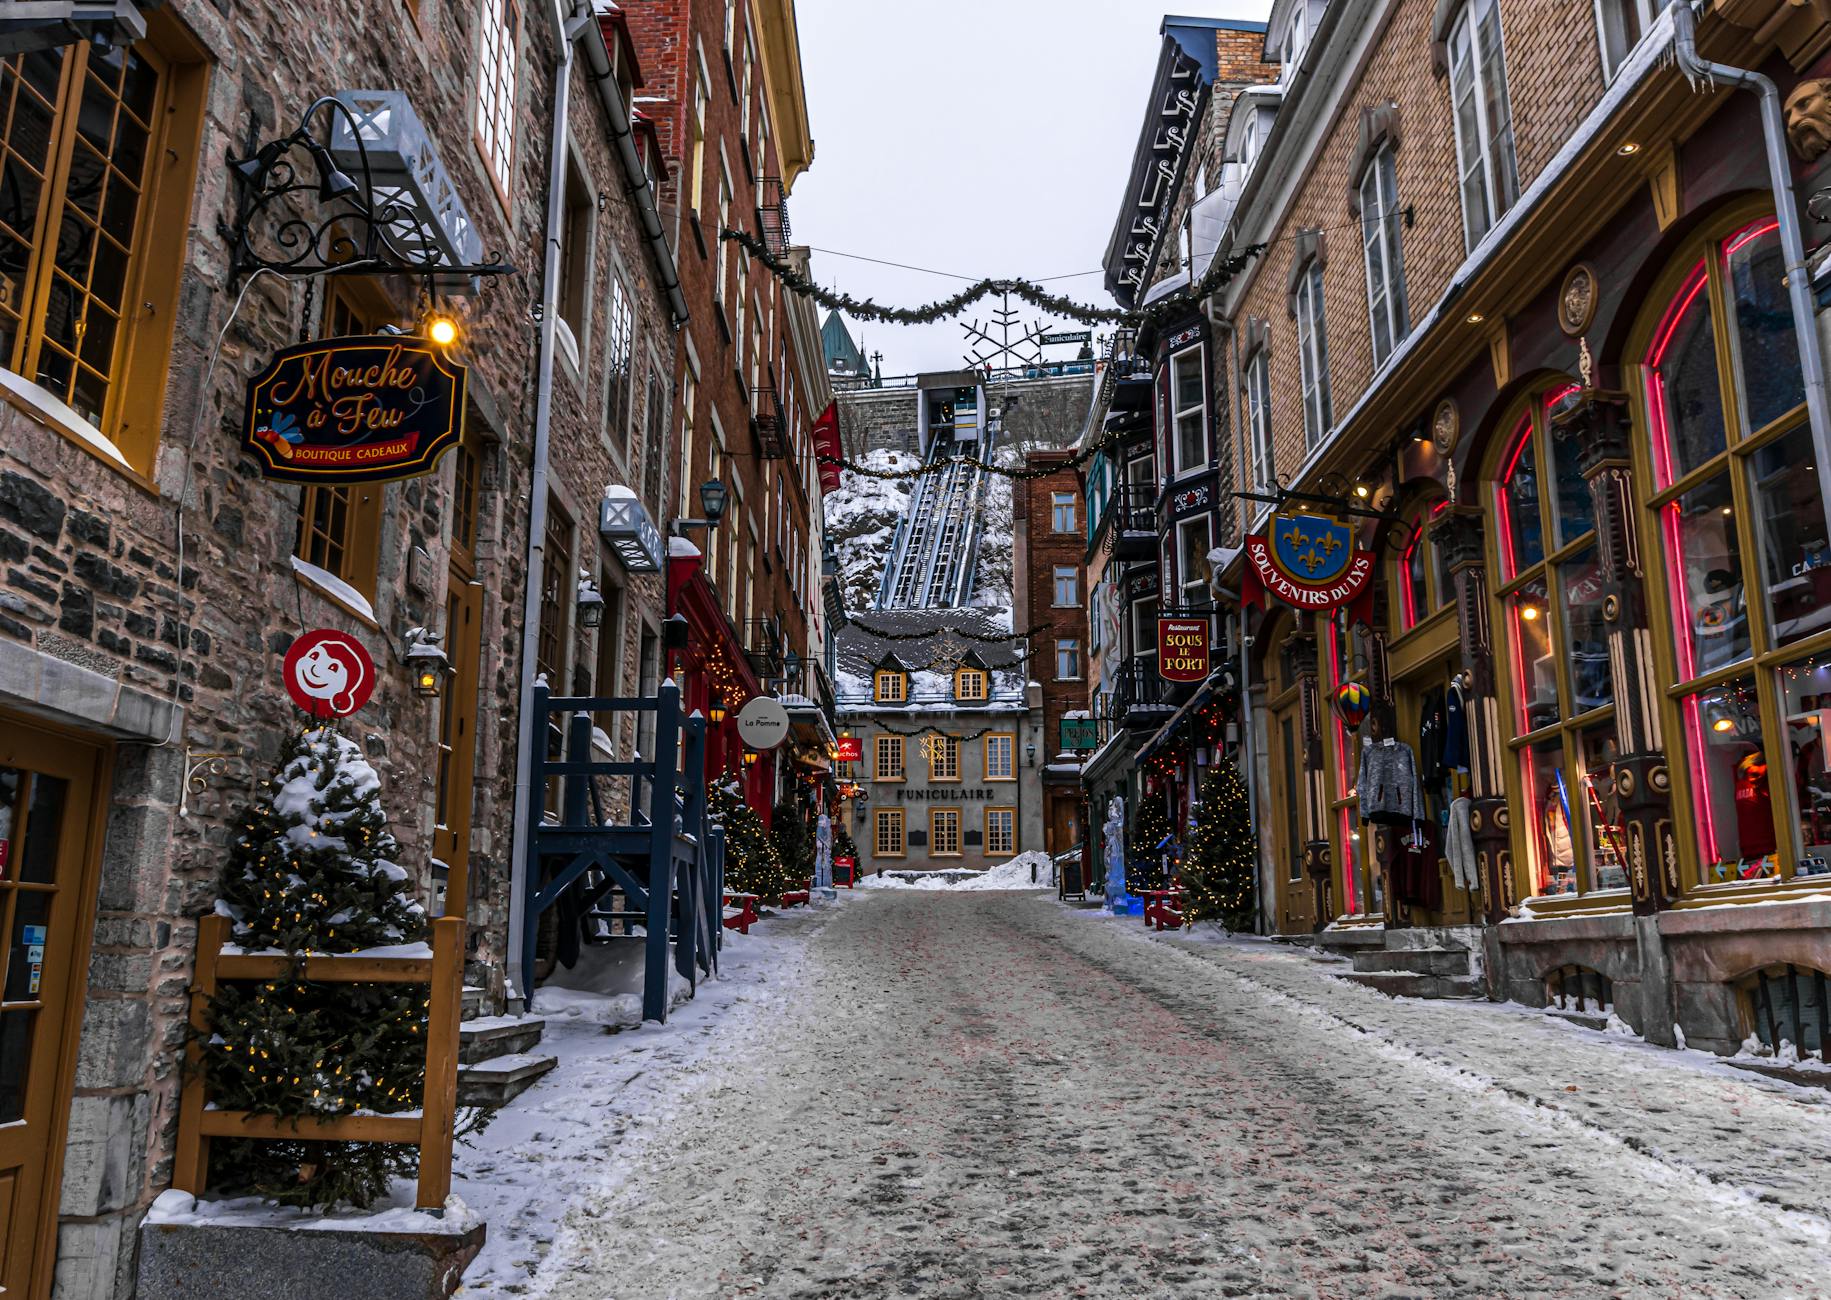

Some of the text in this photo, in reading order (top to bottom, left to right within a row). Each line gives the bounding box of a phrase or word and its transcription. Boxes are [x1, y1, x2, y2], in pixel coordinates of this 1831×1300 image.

[270, 343, 417, 406] Mouche
[307, 392, 405, 434] à Feu
[295, 442, 408, 460] BOUTIQUE CADEAUX
[1251, 543, 1369, 604] SOUVENIRS DU LYS
[1165, 634, 1203, 647] SOUS
[1179, 647, 1191, 656] LE
[1164, 658, 1206, 670] FORT
[896, 789, 994, 800] FUNICULAIRE
